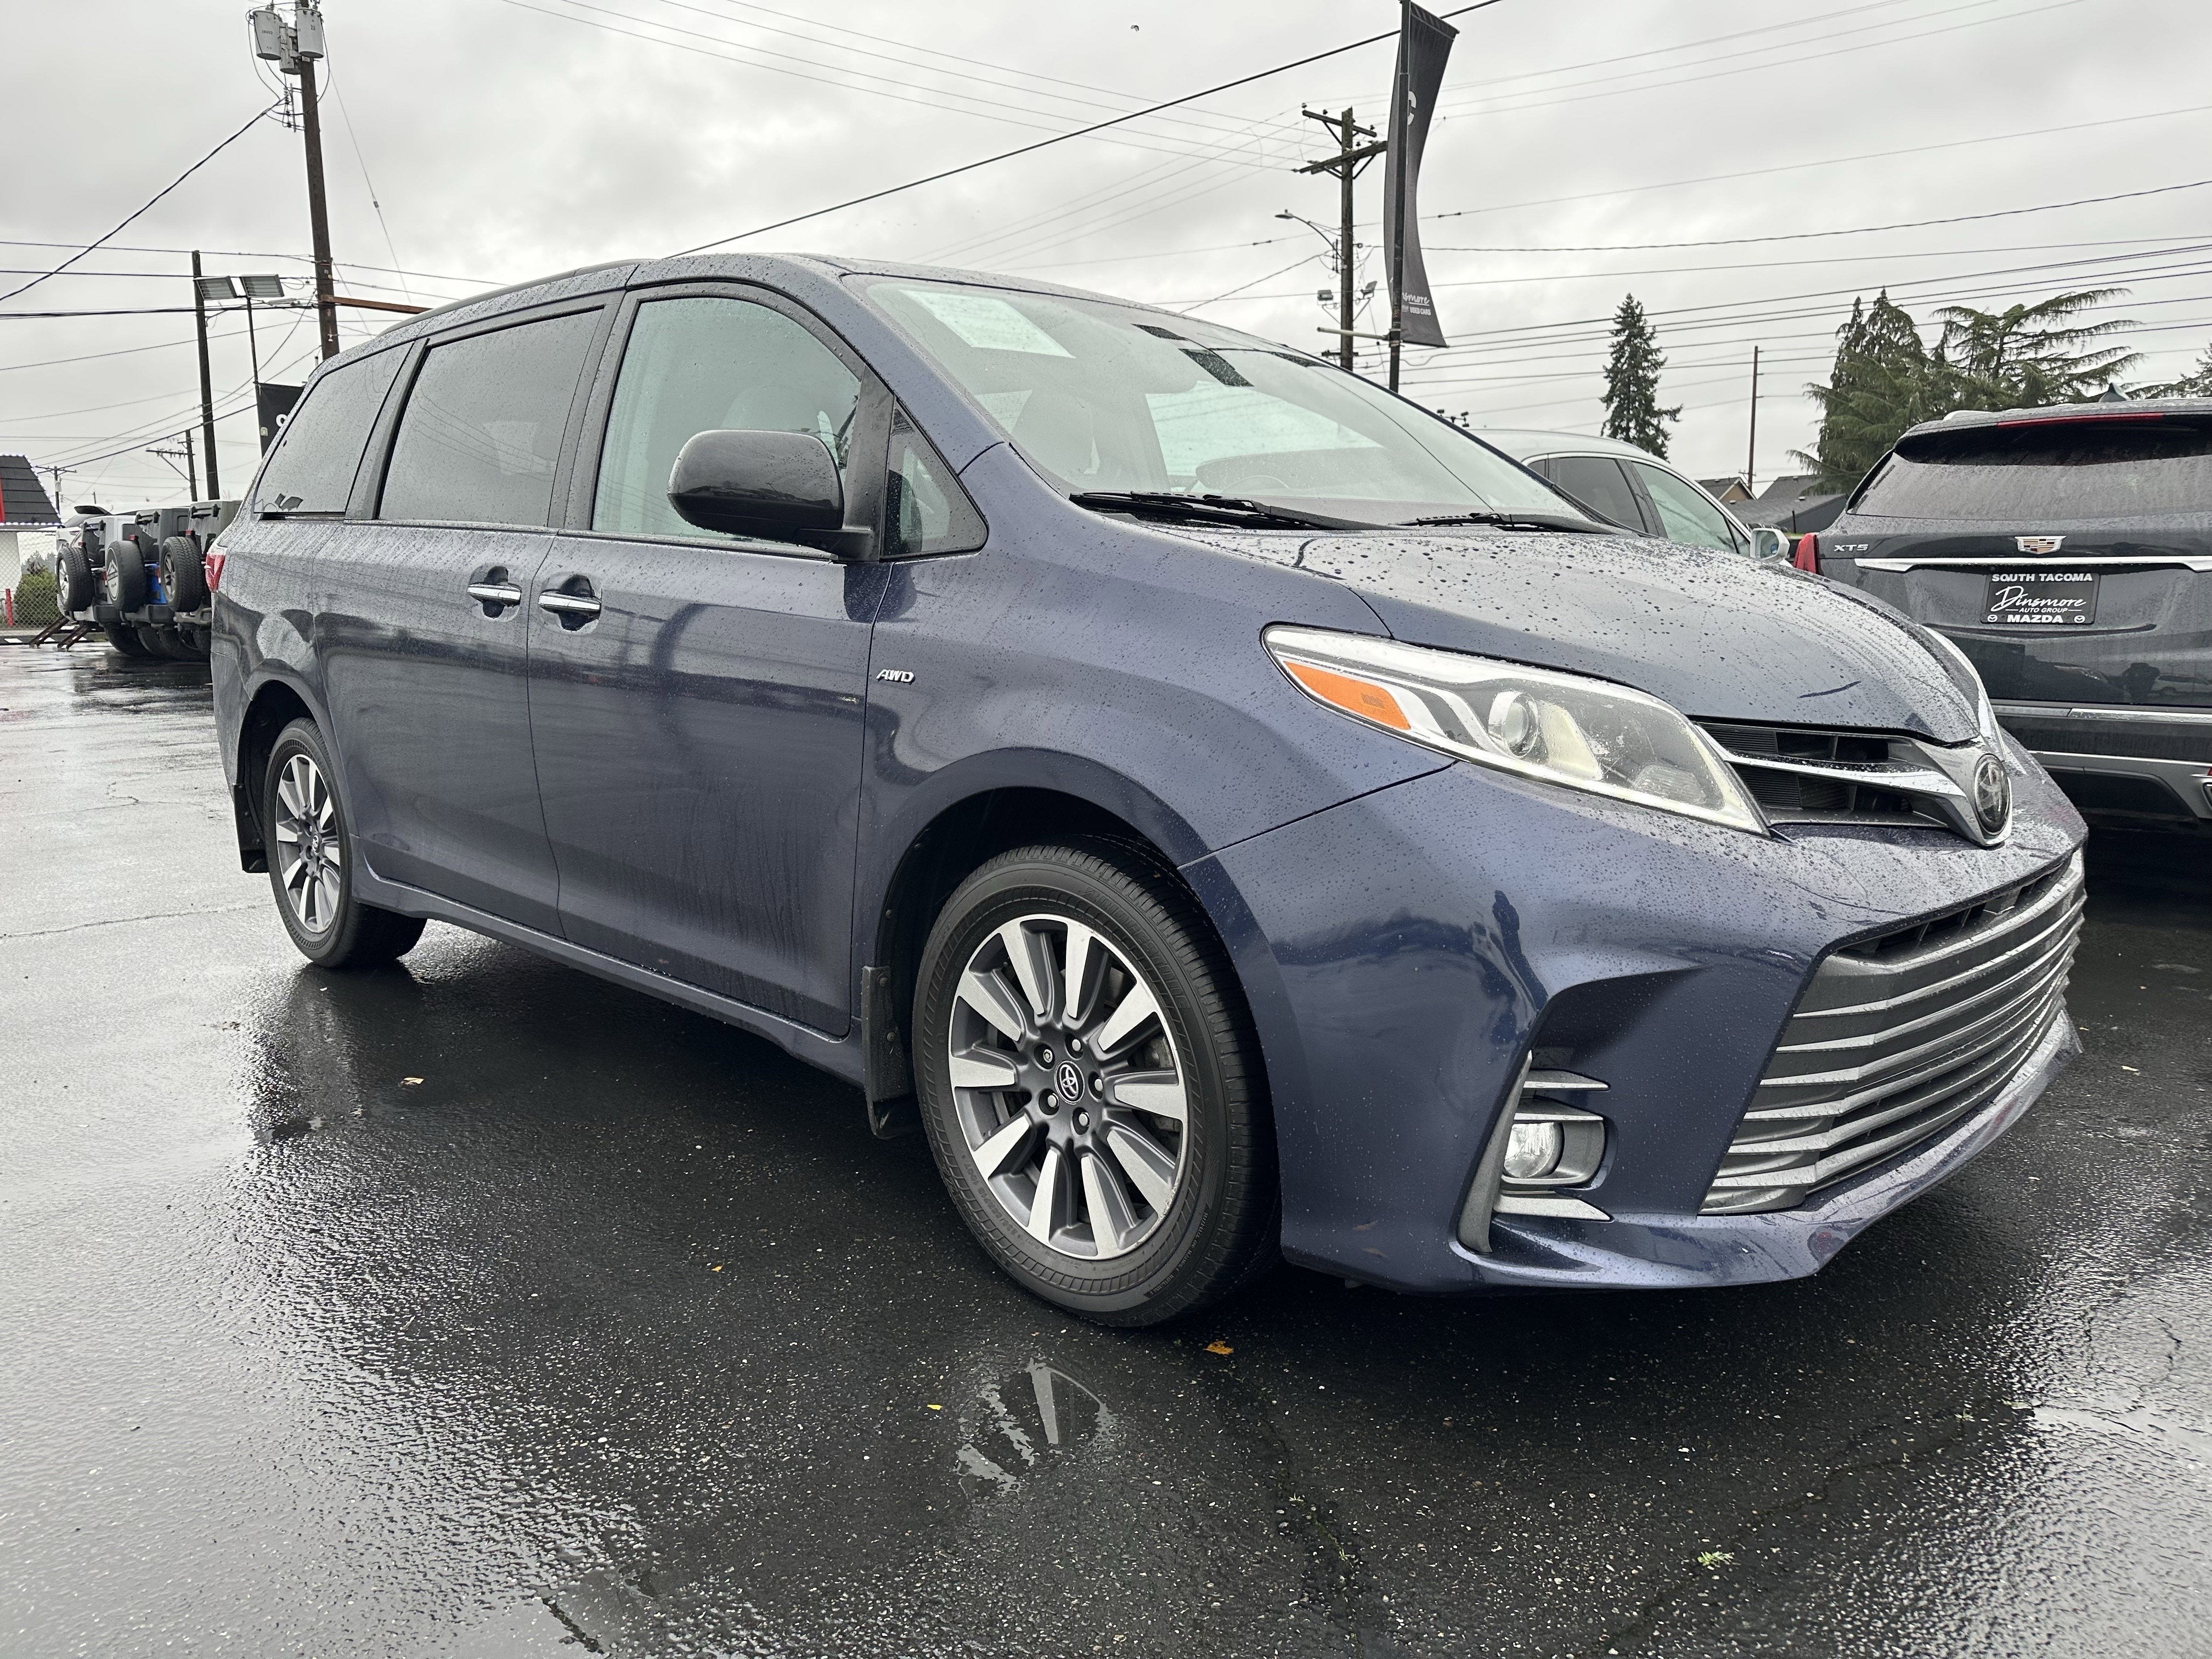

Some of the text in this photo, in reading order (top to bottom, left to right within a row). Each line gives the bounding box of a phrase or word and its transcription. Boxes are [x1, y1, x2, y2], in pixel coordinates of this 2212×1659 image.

[1991, 573, 2093, 582] SOUTH TACOMA
[1990, 585, 2087, 612] Dinsmore
[2007, 614, 2064, 623] MAZDA
[876, 669, 915, 683] AWD
